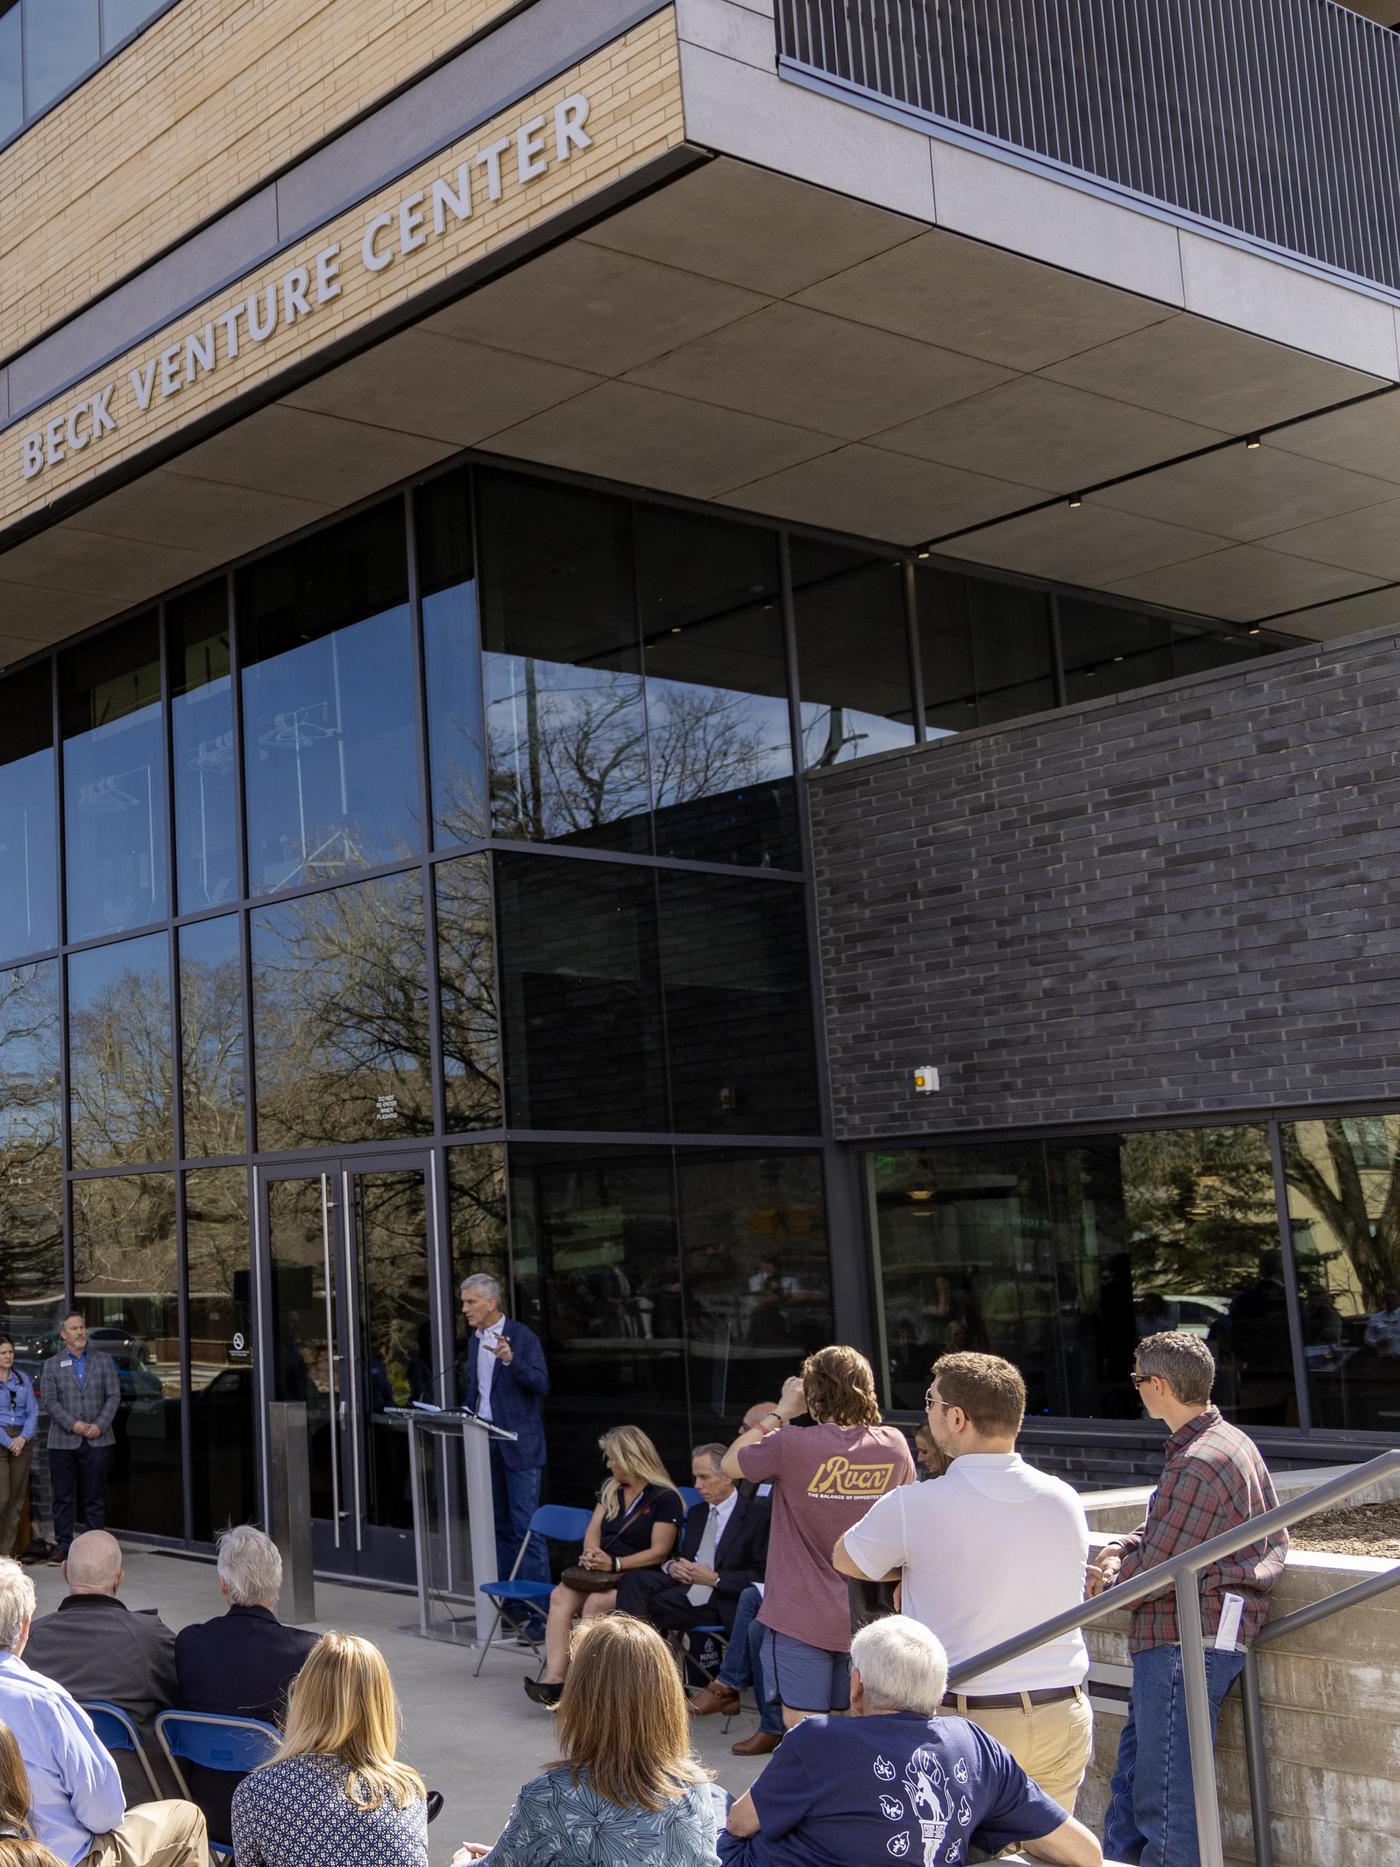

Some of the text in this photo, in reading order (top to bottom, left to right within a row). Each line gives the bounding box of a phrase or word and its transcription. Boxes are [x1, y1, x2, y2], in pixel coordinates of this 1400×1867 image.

[24, 93, 593, 480] BECK VENTURE CENTER
[376, 1100, 397, 1108] RE-ENTER
[376, 1112, 398, 1120] FLASHING
